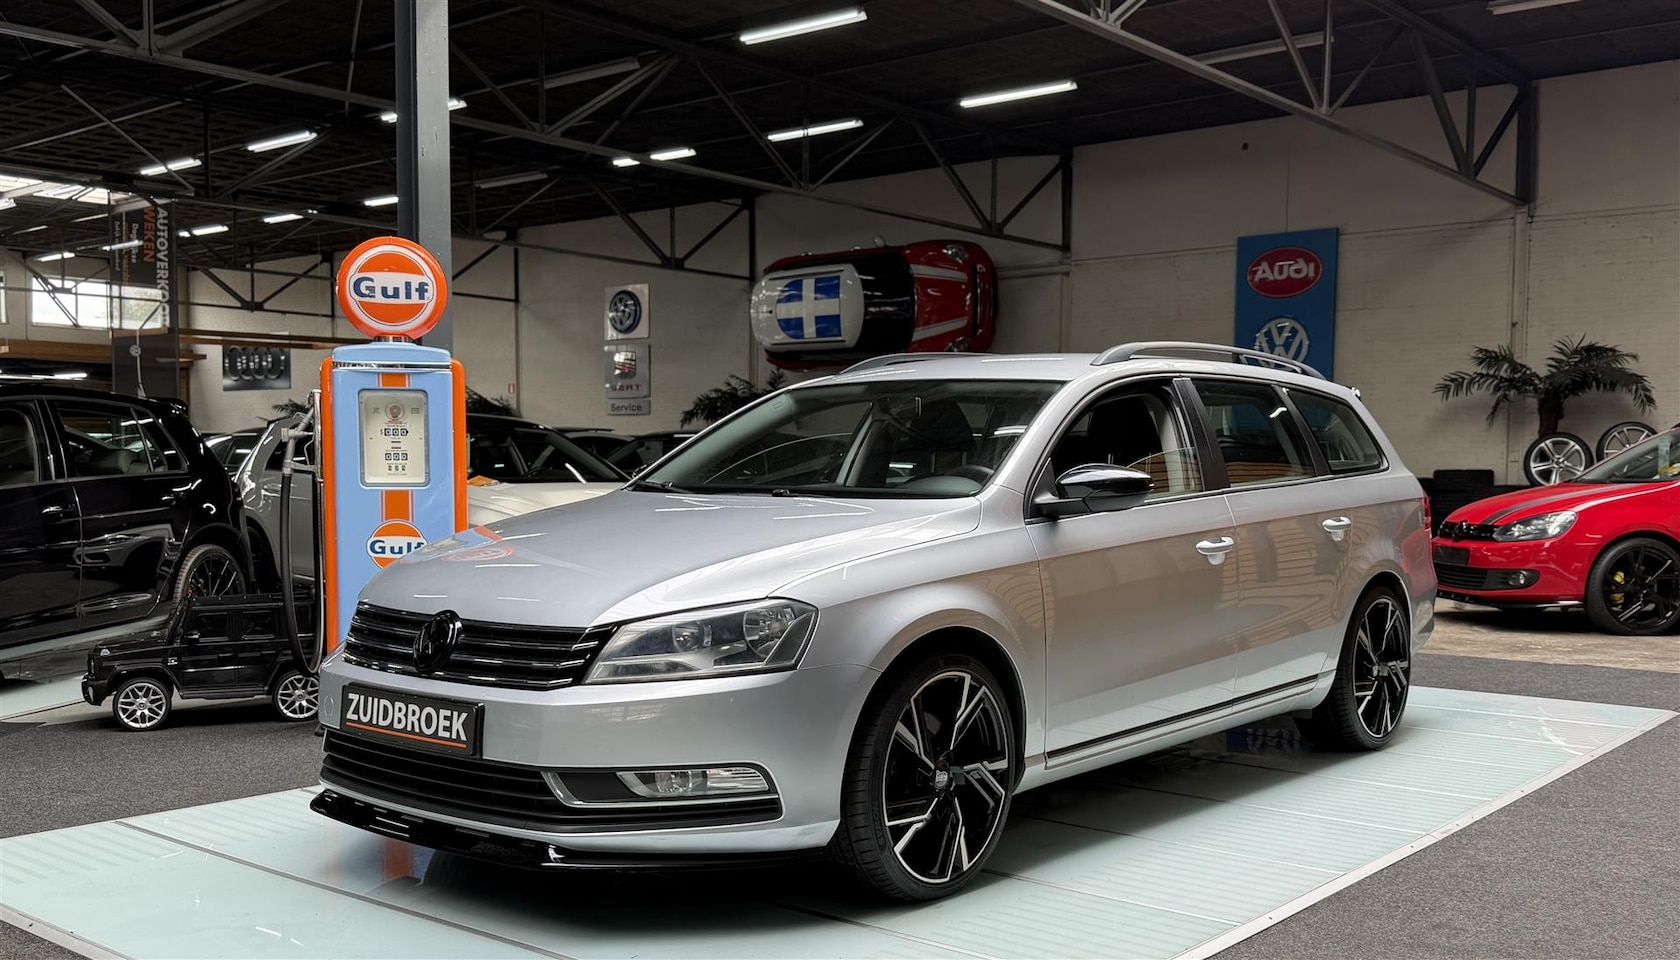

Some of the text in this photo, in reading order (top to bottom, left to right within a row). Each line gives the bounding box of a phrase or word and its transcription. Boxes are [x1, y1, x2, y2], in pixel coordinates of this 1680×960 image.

[143, 206, 155, 263] WEKEN
[353, 276, 429, 300] Gulf
[610, 403, 642, 413] Service
[346, 692, 468, 741] ZUIDBROEK
